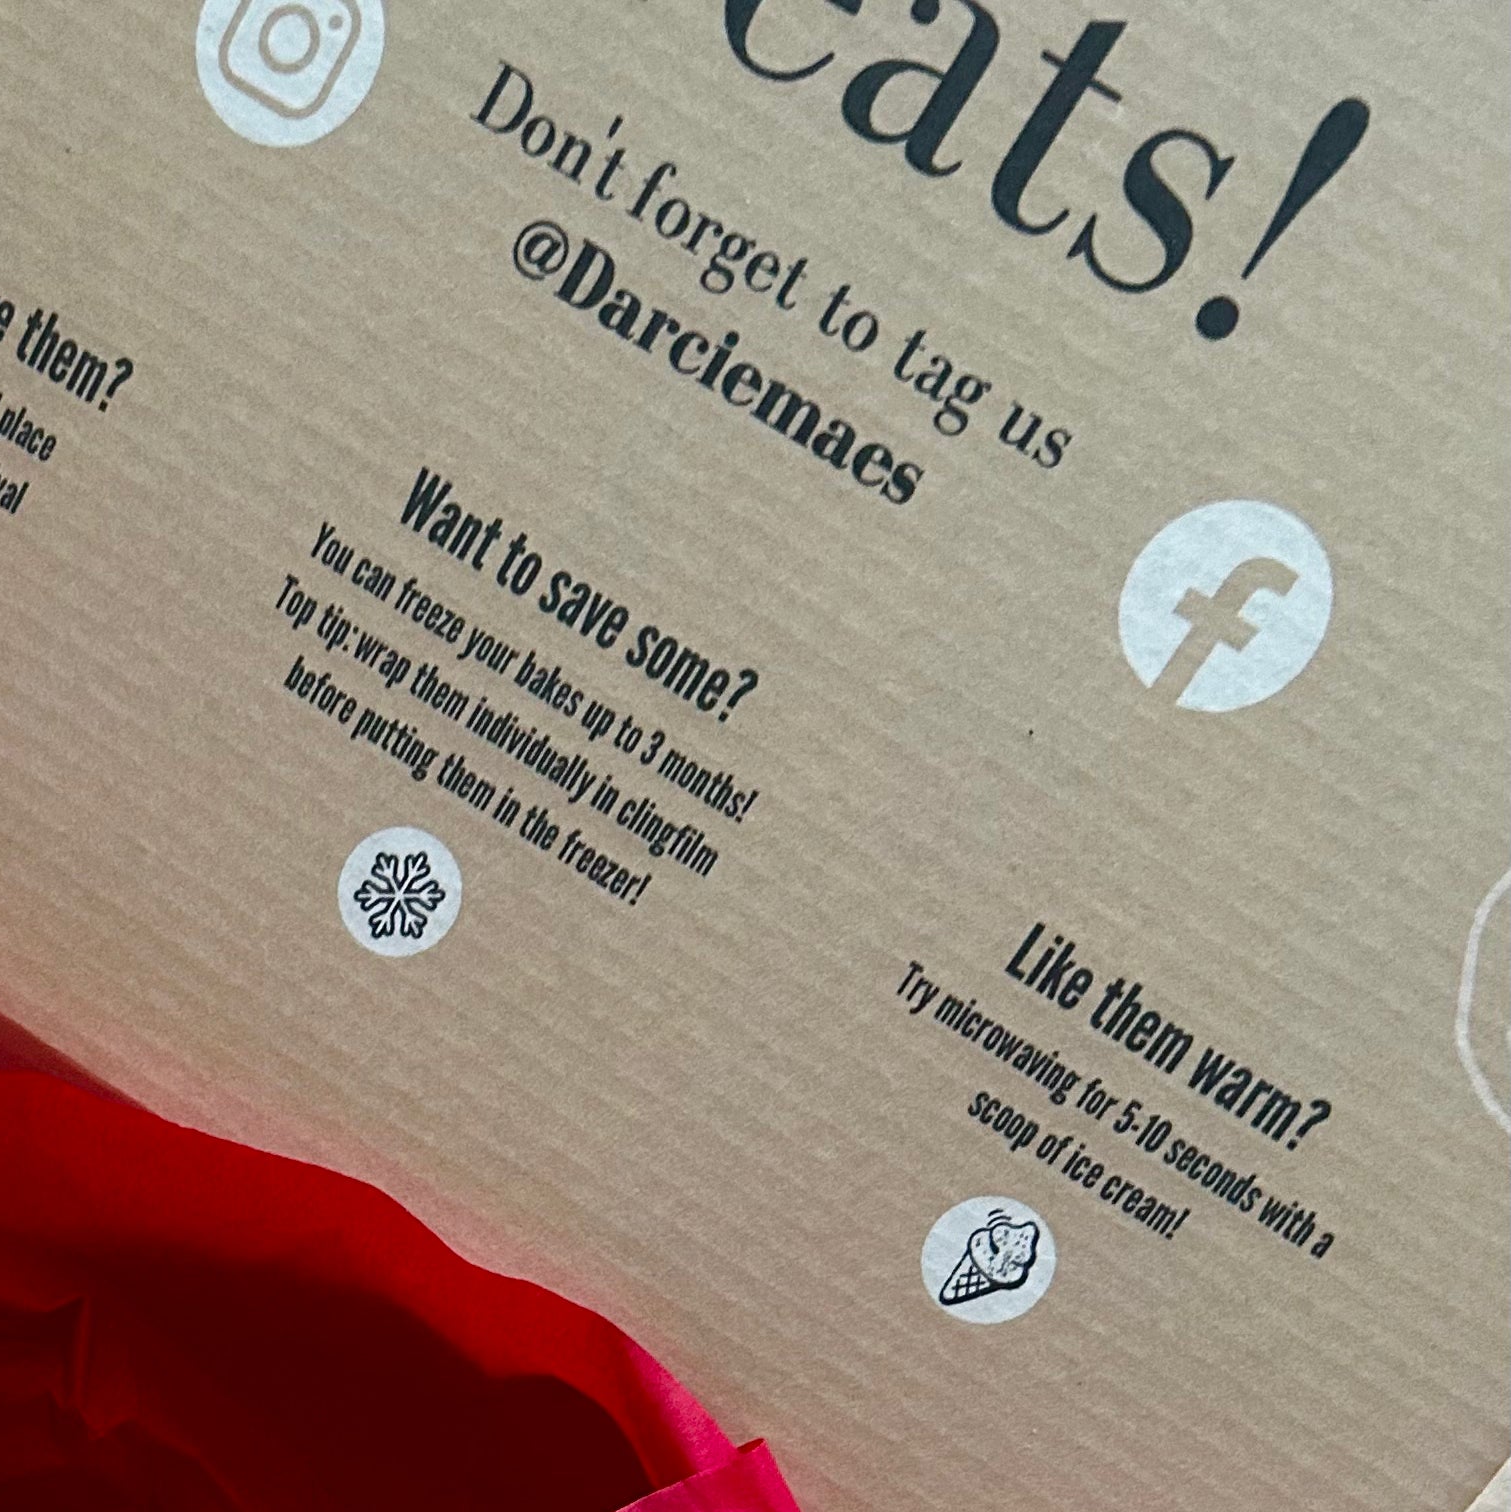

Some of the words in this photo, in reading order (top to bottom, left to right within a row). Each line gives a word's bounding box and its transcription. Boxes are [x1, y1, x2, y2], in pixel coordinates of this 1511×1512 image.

[16, 307, 134, 413] them?
[470, 60, 626, 201] Don't
[626, 161, 808, 311] forget
[818, 284, 879, 353] to
[893, 329, 992, 437] tag
[998, 401, 1073, 469] us
[512, 219, 925, 505] @Darciemaes
[275, 573, 318, 631] Top
[409, 662, 470, 722] them
[465, 696, 598, 805] individually
[589, 774, 620, 816] in
[616, 797, 719, 878] clingfilm
[310, 521, 355, 577] You
[350, 557, 397, 602] can
[393, 577, 466, 645] freeze
[456, 626, 521, 675] your
[513, 649, 585, 718] bakes
[580, 700, 616, 742] up
[613, 714, 644, 754] to
[639, 729, 666, 766] 3
[656, 748, 760, 824] months!
[400, 466, 503, 572] Want
[496, 532, 543, 597] to
[538, 570, 630, 650] save
[625, 625, 759, 723] some?
[283, 654, 358, 725] before
[350, 707, 440, 782] putting
[436, 752, 497, 812] them
[491, 786, 522, 829] in
[518, 805, 560, 851] the
[557, 828, 653, 906] freezer!
[896, 960, 941, 1015] Try
[933, 993, 1083, 1106] microwaving
[1075, 1077, 1120, 1121] for
[1112, 1099, 1173, 1153] 5-10
[1163, 1138, 1263, 1213] seconds
[1257, 1195, 1317, 1248] with
[1310, 1232, 1335, 1260] a
[967, 1091, 1040, 1153] scoop
[1035, 1133, 1075, 1166] of
[1060, 1142, 1105, 1189] ice
[1099, 1175, 1191, 1241] cream!
[1004, 921, 1094, 1011] Like
[1089, 977, 1194, 1075] them
[1187, 1046, 1332, 1151] warm?
